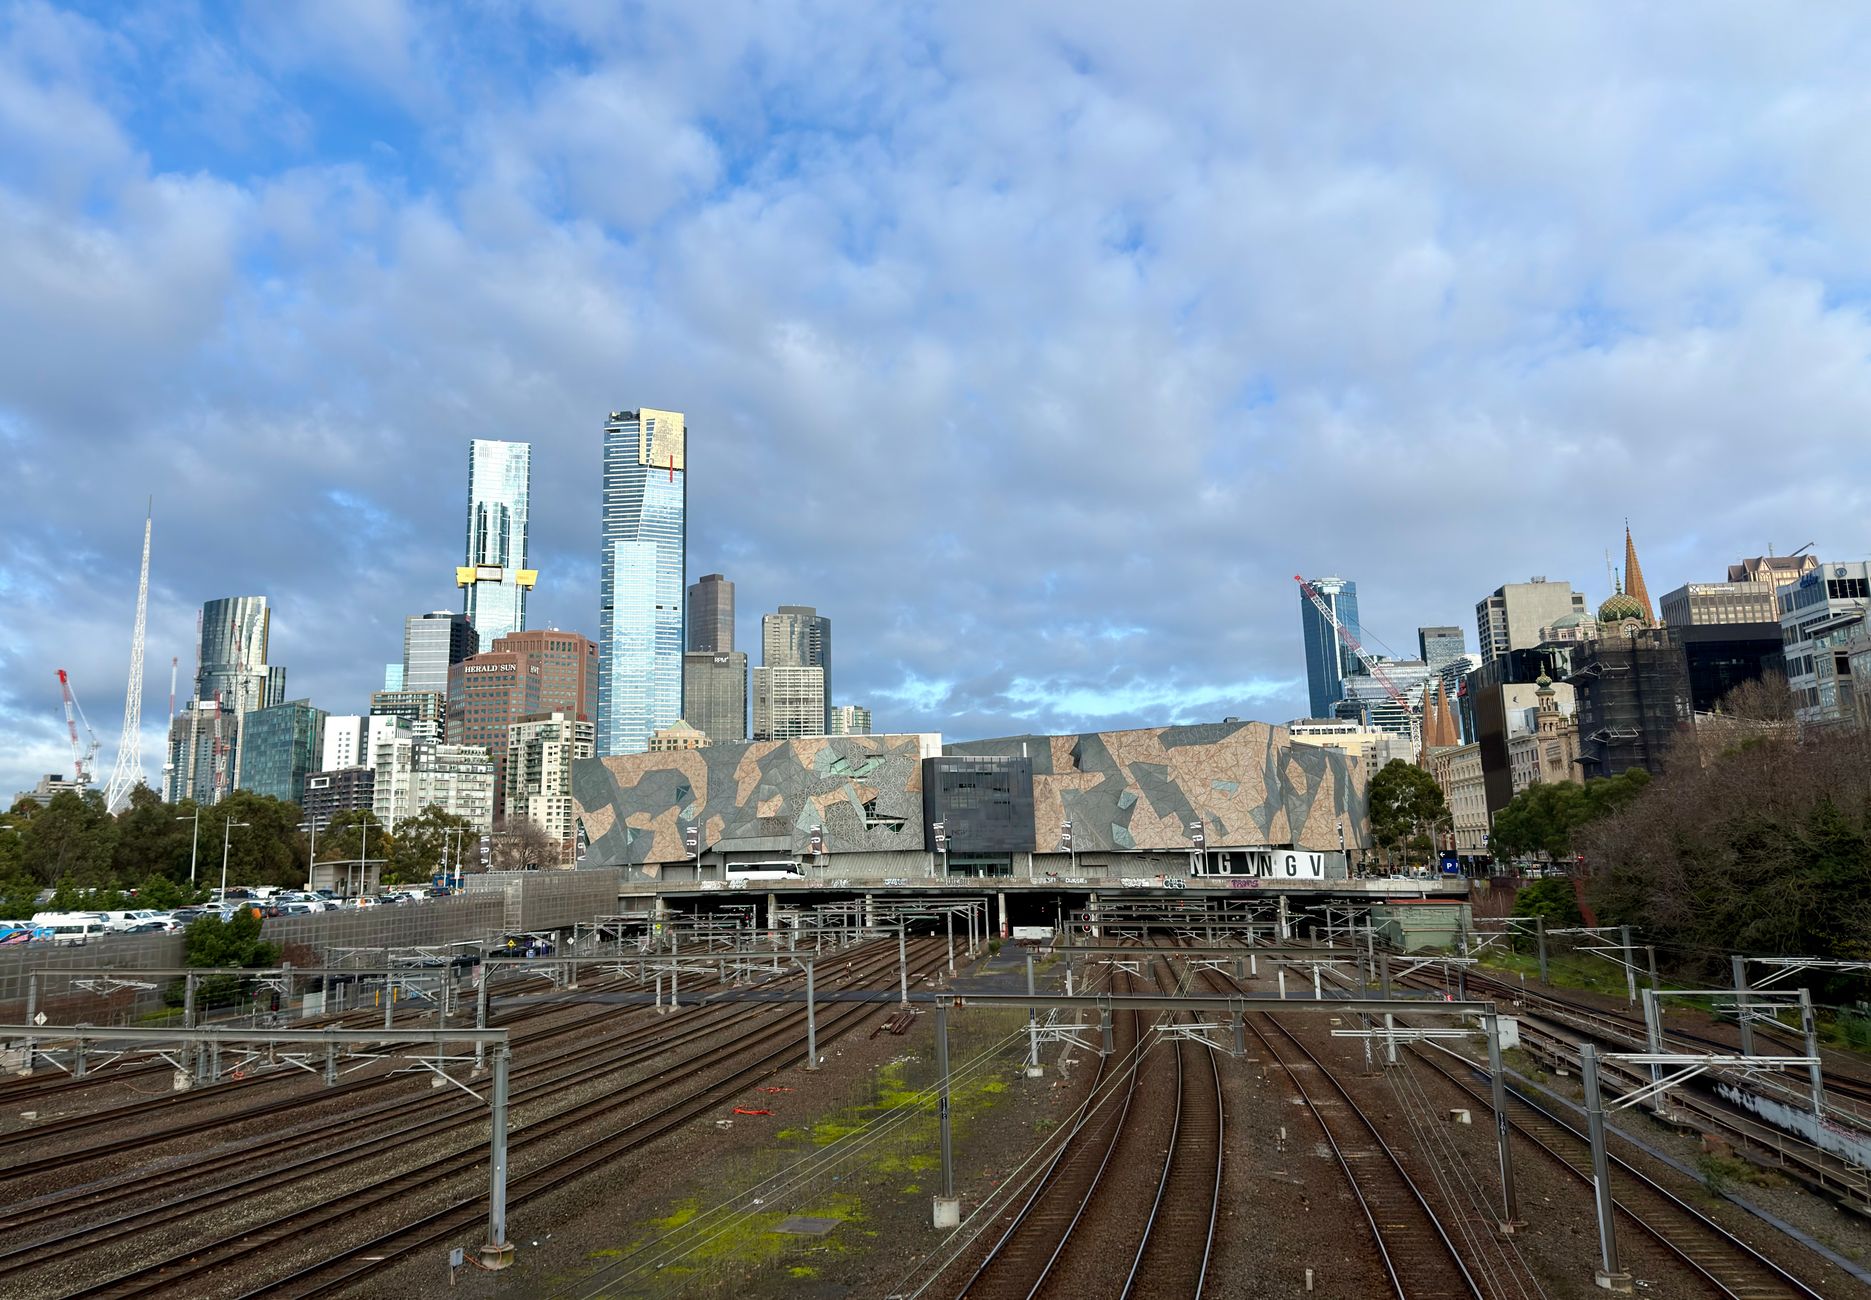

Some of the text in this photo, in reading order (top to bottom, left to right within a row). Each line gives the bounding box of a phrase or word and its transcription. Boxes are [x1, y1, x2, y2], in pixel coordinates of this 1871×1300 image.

[464, 664, 517, 673] HERALD SUN
[686, 826, 698, 858] NGV
[1261, 855, 1322, 877] NGV
[1446, 862, 1453, 870] P
